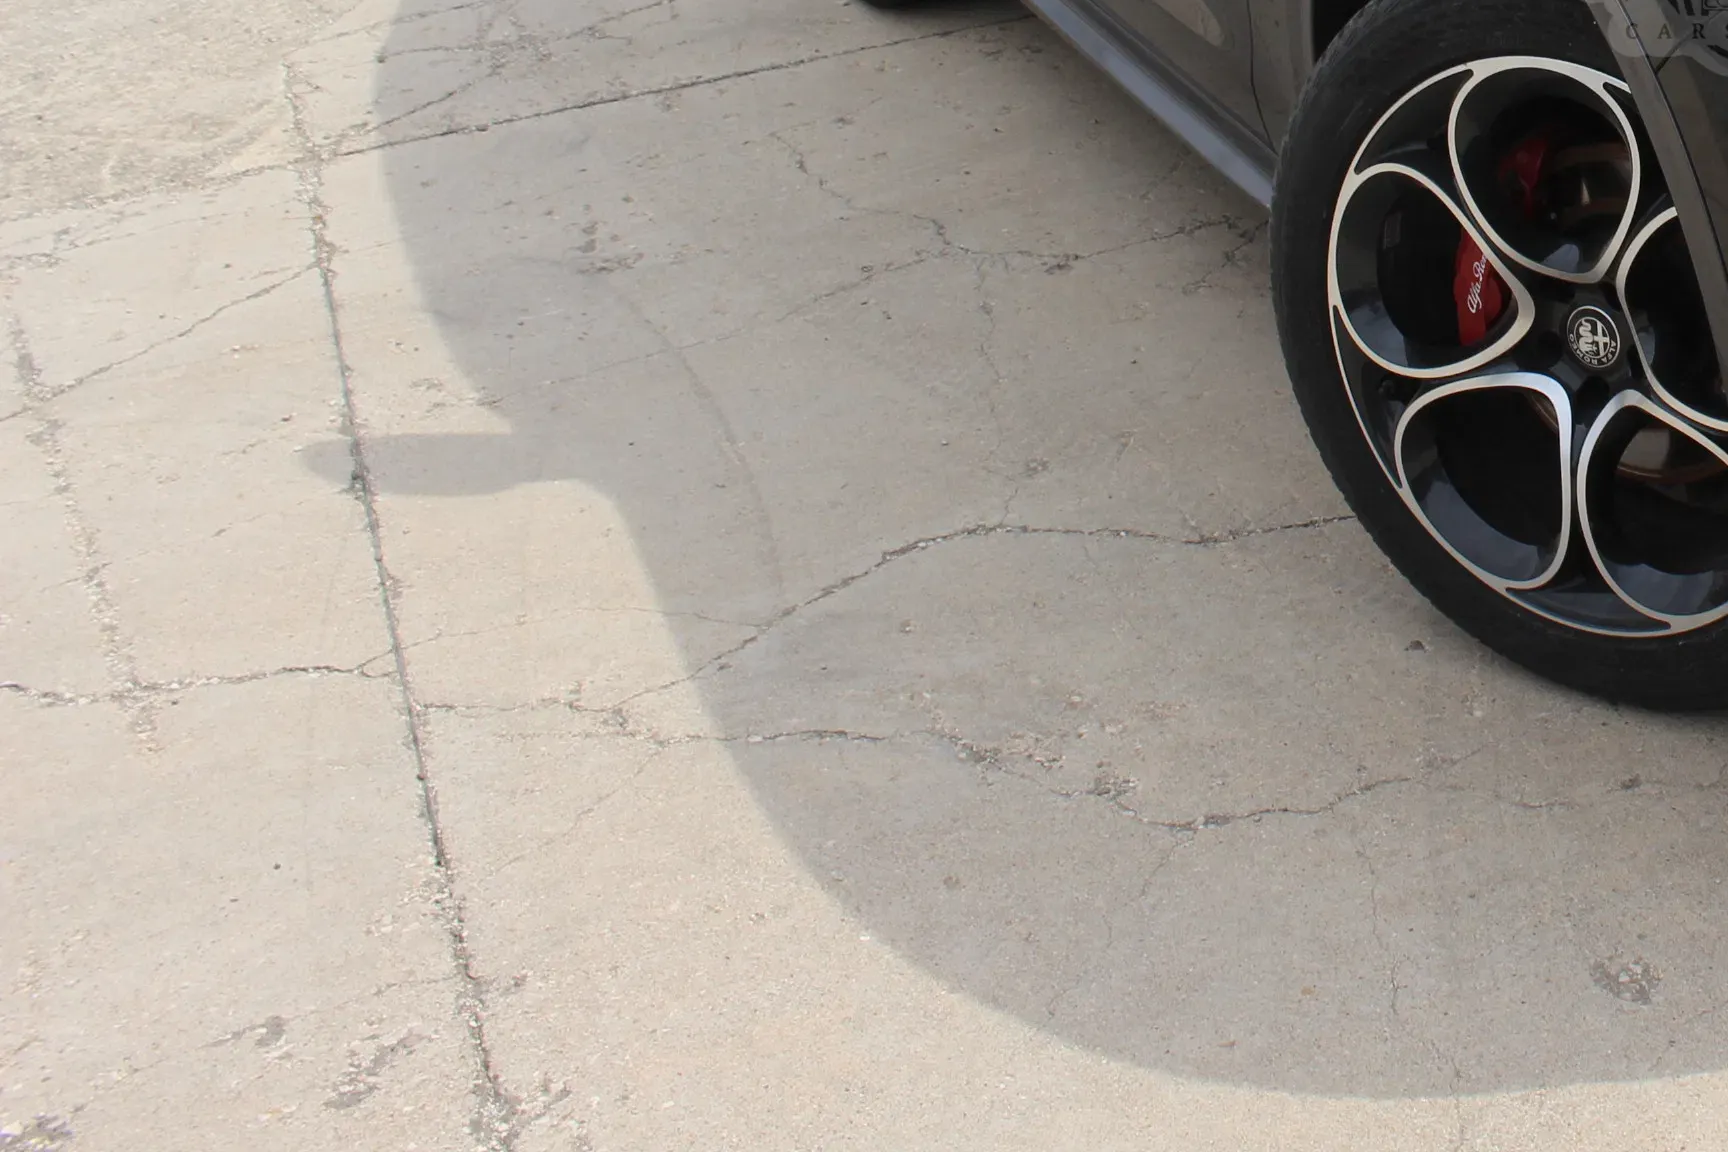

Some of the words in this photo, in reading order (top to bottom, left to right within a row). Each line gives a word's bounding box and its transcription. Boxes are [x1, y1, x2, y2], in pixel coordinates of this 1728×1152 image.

[1467, 280, 1483, 314] Alfa
[1569, 333, 1599, 366] ROMEO
[1600, 339, 1617, 364] ALFA
